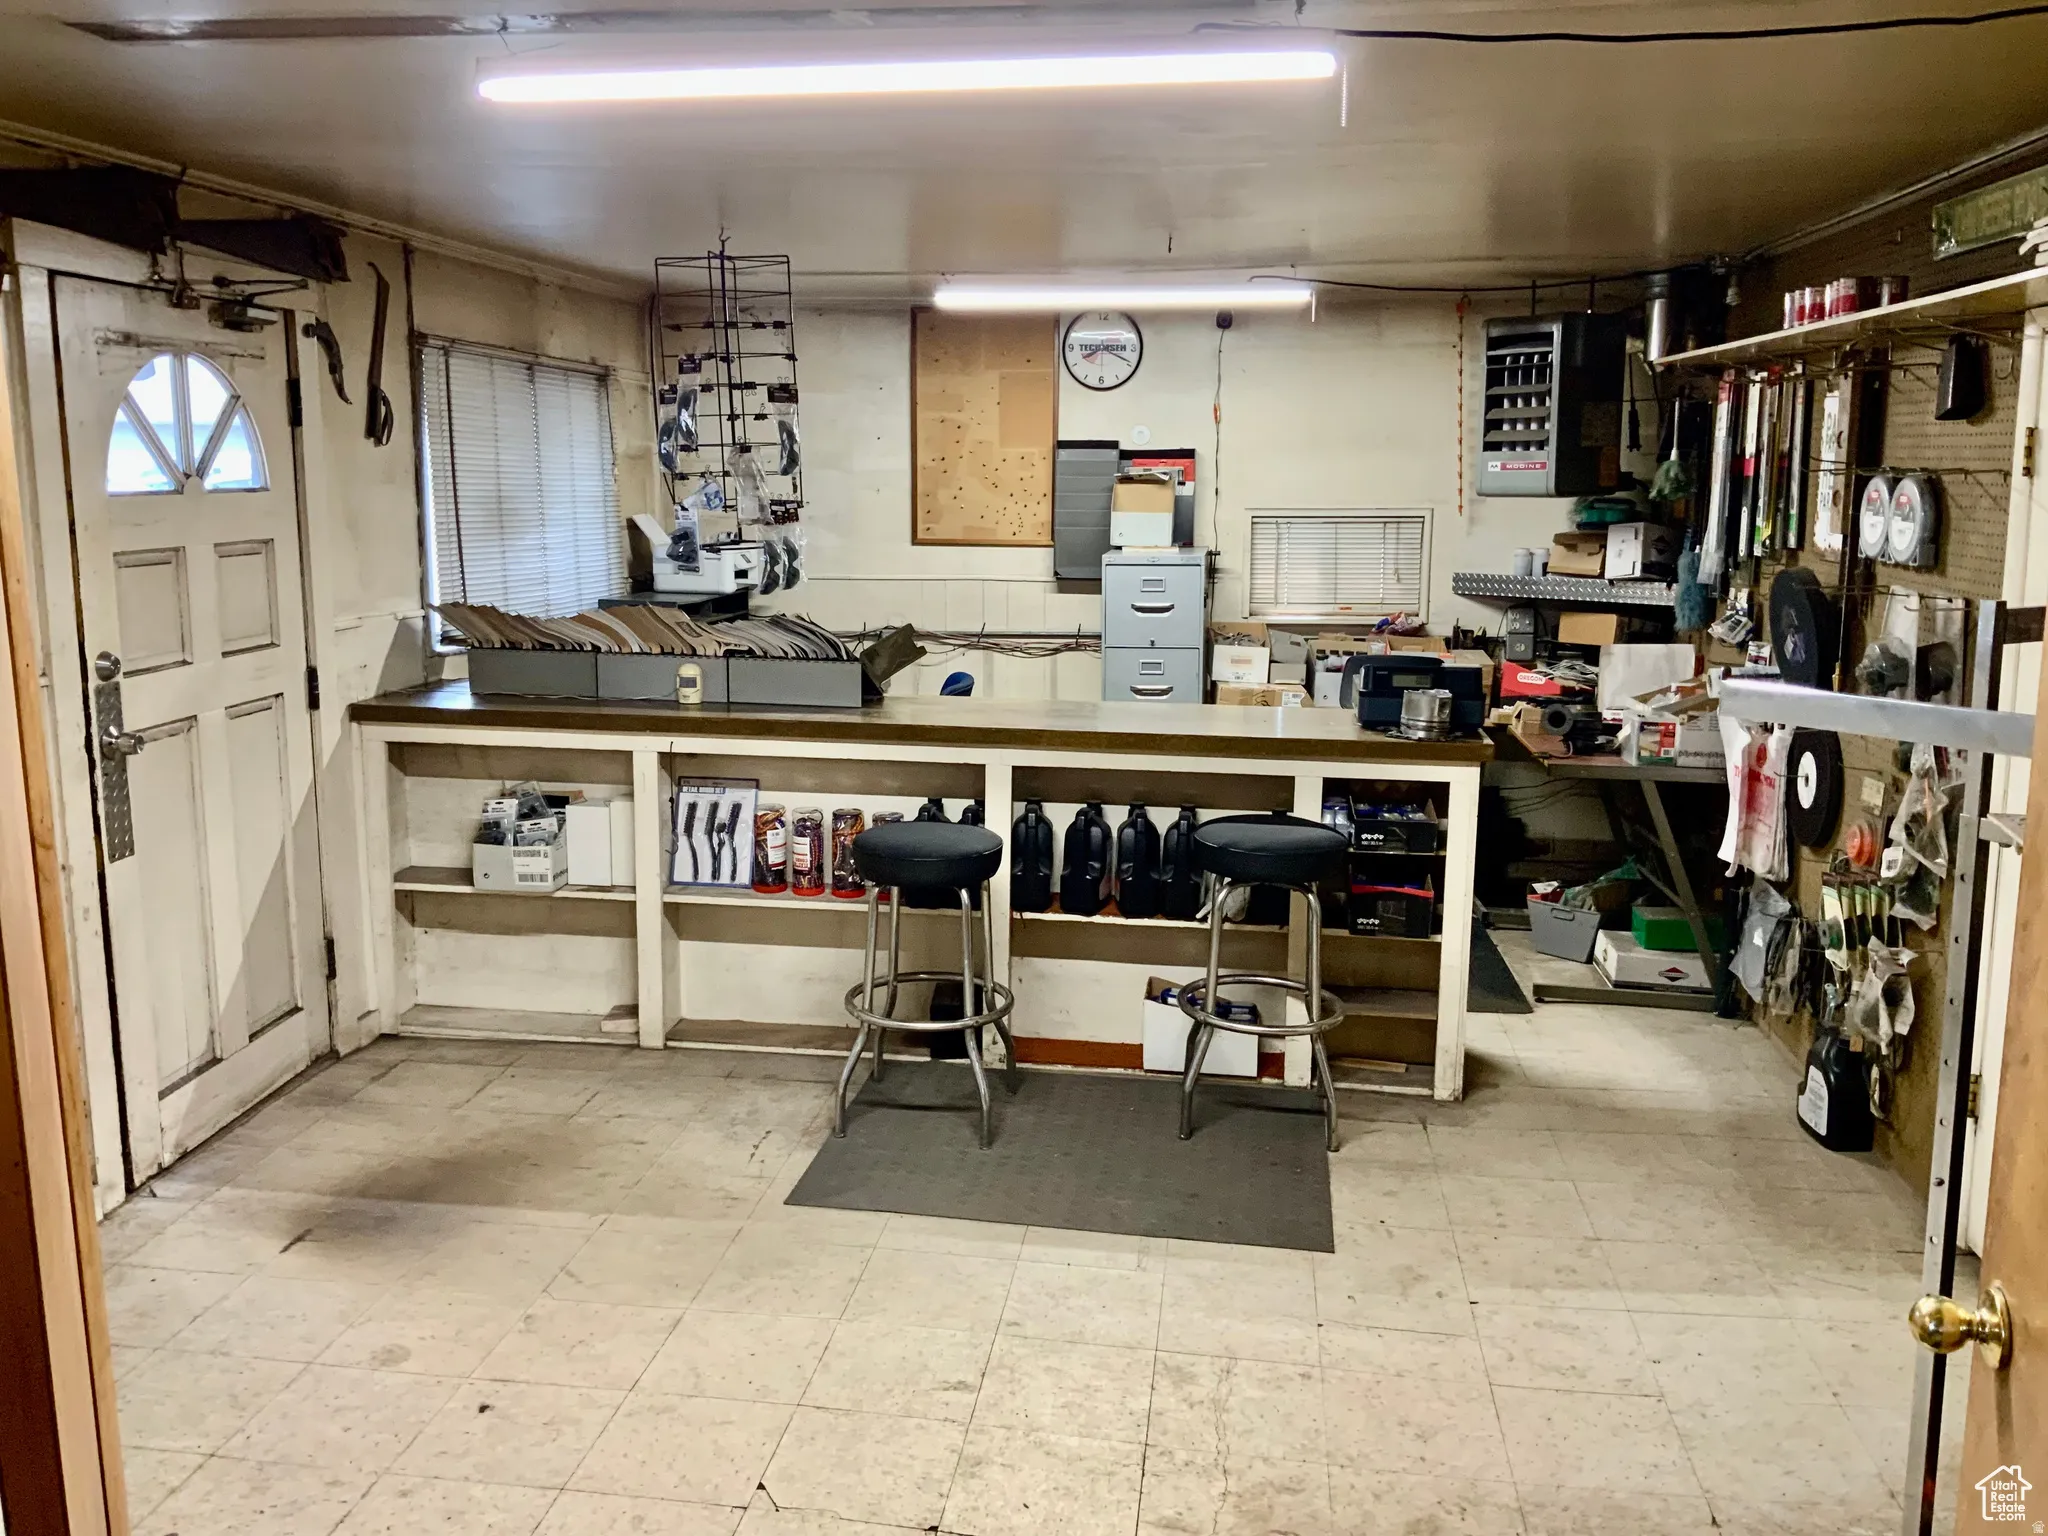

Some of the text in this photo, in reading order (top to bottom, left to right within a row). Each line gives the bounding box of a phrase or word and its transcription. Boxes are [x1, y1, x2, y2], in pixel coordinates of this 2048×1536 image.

[1098, 312, 1109, 321] 12
[1068, 344, 1074, 352] 9
[1130, 344, 1137, 352] 3
[1098, 376, 1105, 385] 6
[1518, 674, 1544, 682] OREGON
